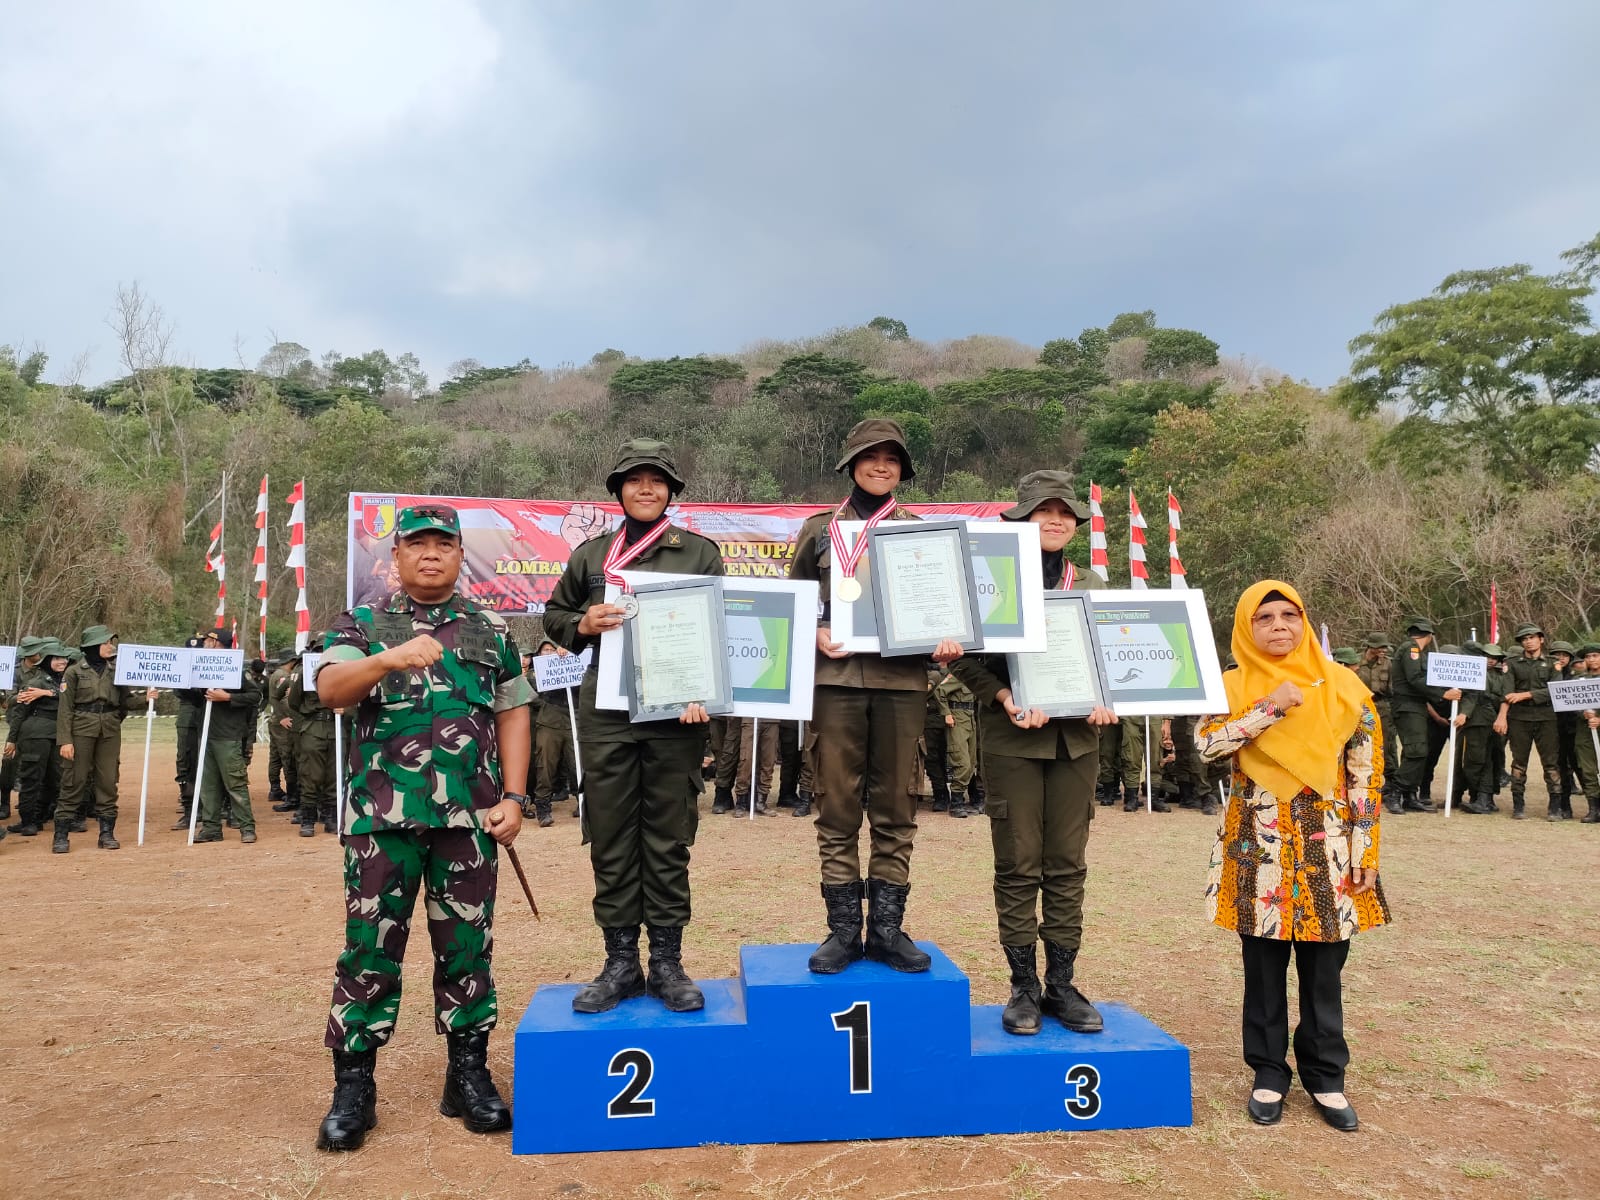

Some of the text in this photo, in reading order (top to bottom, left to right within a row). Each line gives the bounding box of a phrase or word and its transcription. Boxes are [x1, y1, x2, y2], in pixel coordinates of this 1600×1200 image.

[496, 560, 563, 575] LOMBA
[724, 562, 779, 577] ENWA
[134, 650, 178, 662] POLITEKNIK
[195, 655, 233, 665] UNIVERSITAS
[547, 655, 581, 668] UNIVERSITAS
[138, 662, 172, 672] NEGERI
[1434, 659, 1481, 670] UNIVERSITAS
[126, 671, 182, 683] BANYUWANGI
[199, 673, 225, 681] MALANG
[1437, 673, 1477, 683] SURABAYA
[1460, 669, 1483, 677] PUTRA
[542, 673, 584, 687] PROBOLING
[830, 1001, 872, 1094] 1
[607, 1047, 656, 1119] 2
[1064, 1063, 1102, 1120] 3
